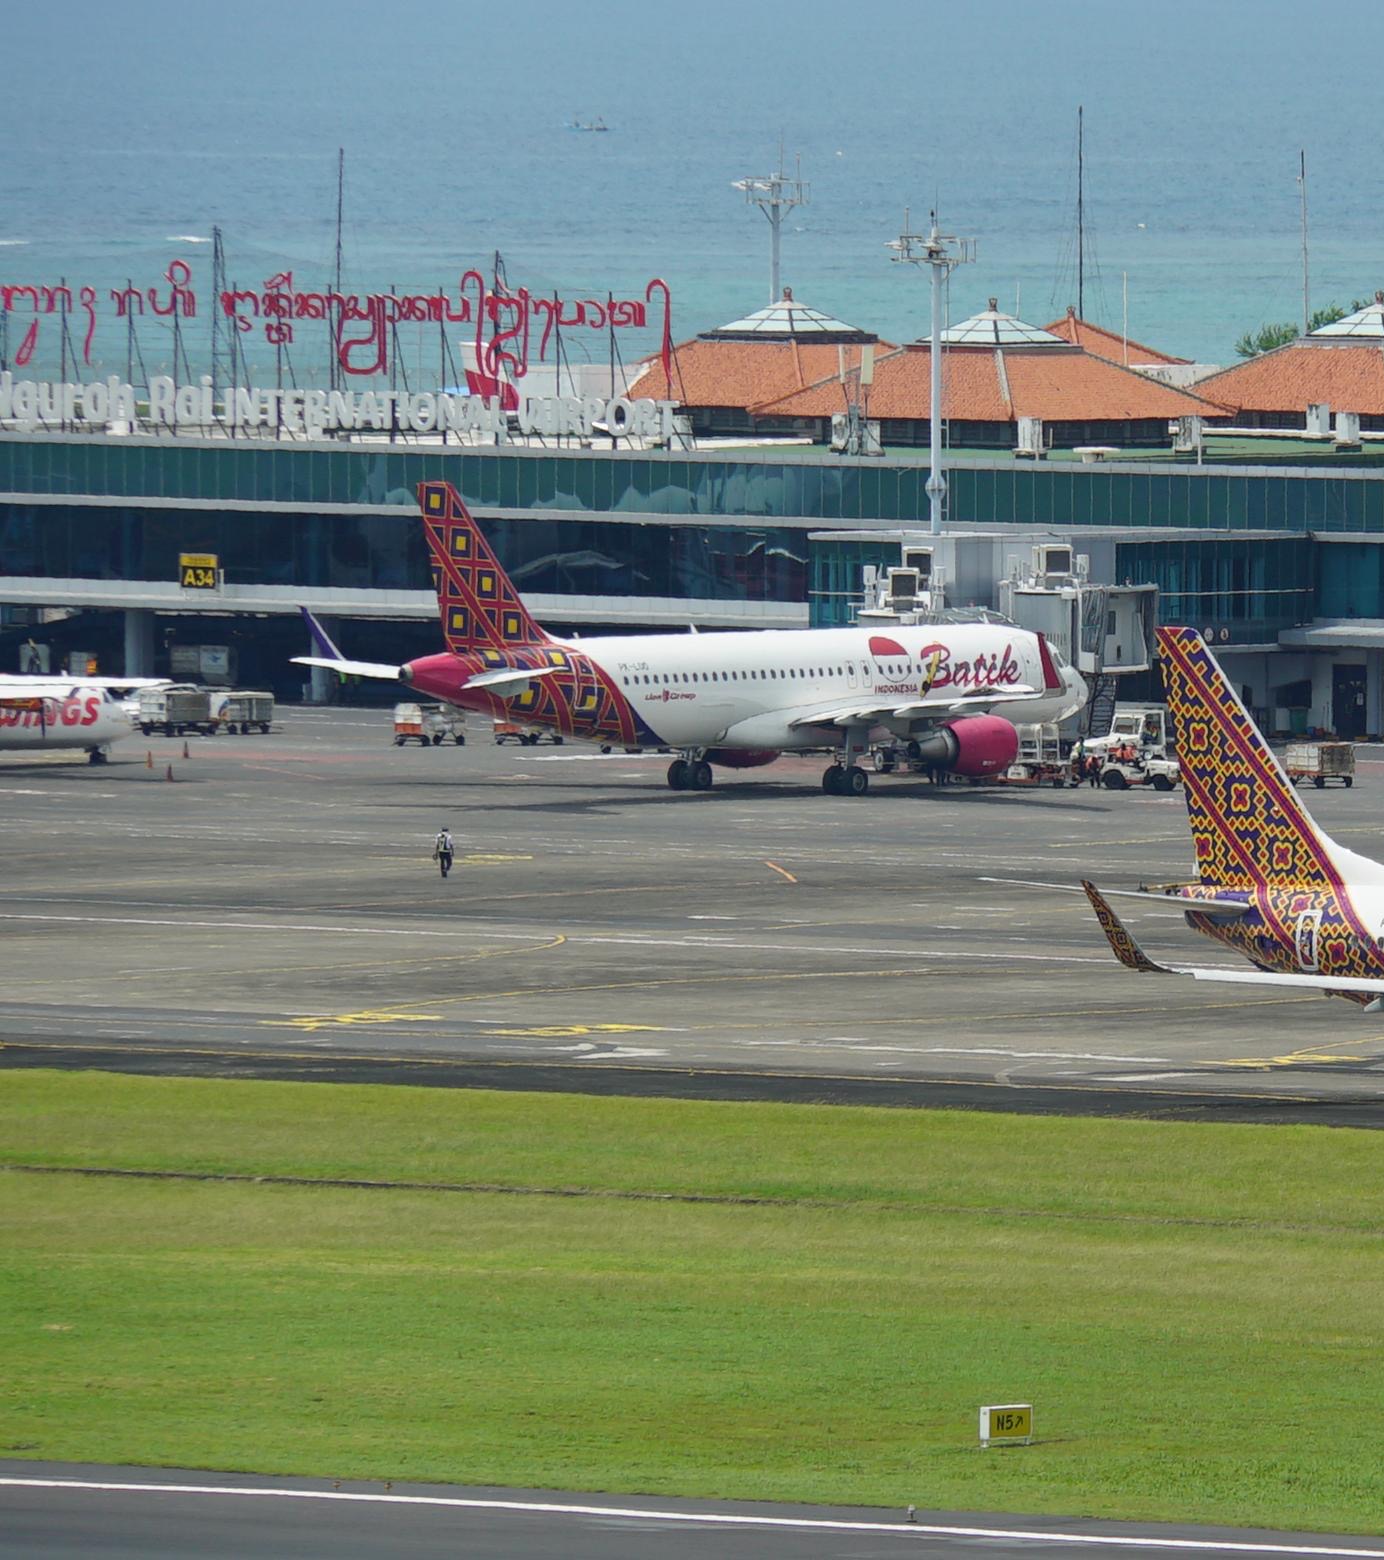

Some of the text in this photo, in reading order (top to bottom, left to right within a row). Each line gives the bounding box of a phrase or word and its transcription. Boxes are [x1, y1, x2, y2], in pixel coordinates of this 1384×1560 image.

[151, 375, 213, 423] Rai
[225, 386, 507, 438] INTERNATIONAL
[517, 396, 680, 440] AIRPORT
[183, 568, 215, 587] A34
[920, 642, 1022, 690] Batik
[874, 684, 919, 695] INDONESIA
[996, 1414, 1014, 1431] N5
